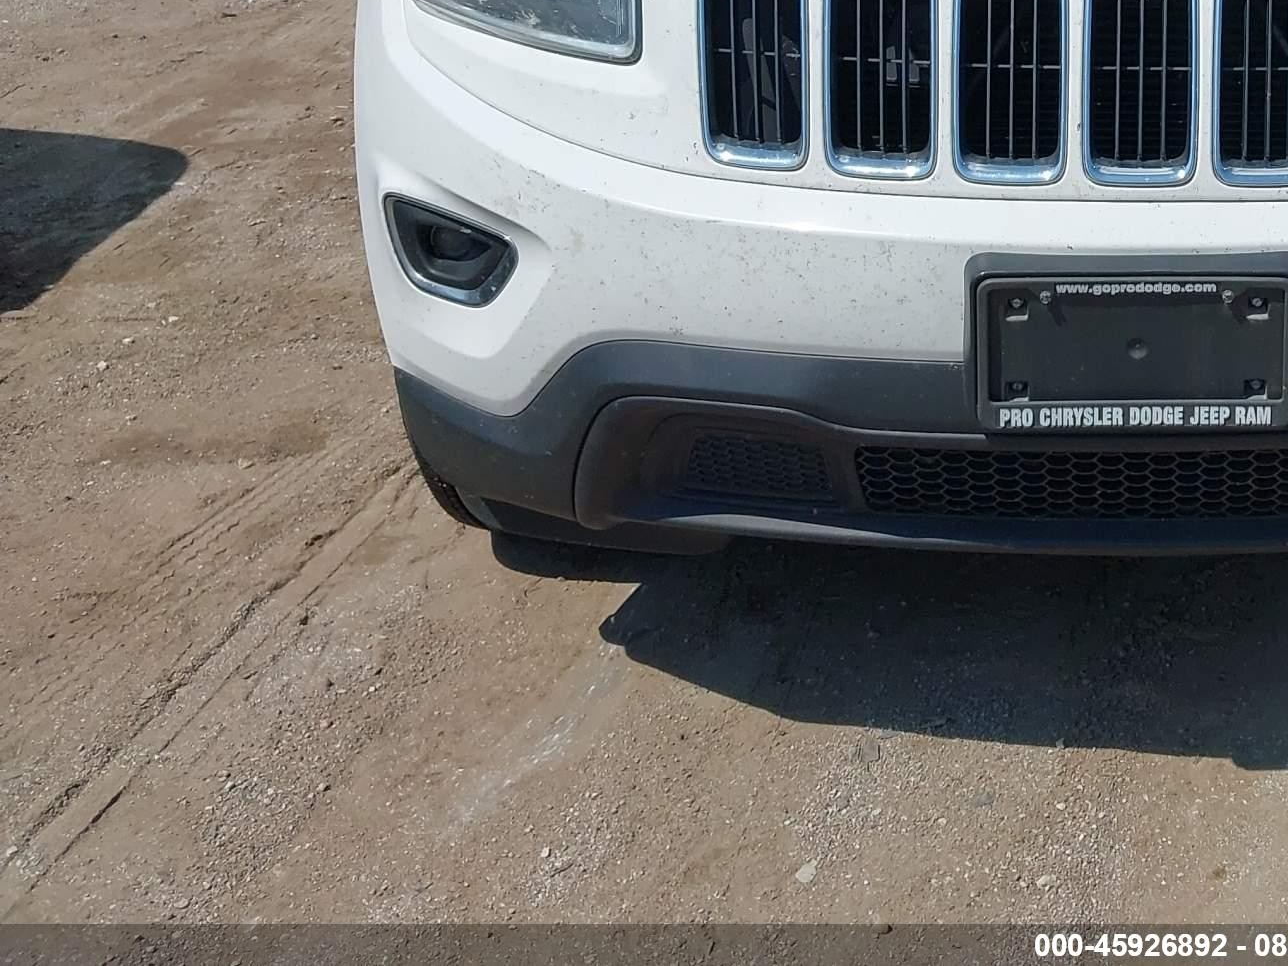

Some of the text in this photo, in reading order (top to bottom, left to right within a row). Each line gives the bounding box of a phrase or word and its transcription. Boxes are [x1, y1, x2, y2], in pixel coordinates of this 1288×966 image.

[1055, 282, 1217, 295] www.goprododge.com
[1000, 406, 1272, 427] PRO CHRYSLER DODGE JEEP RAM
